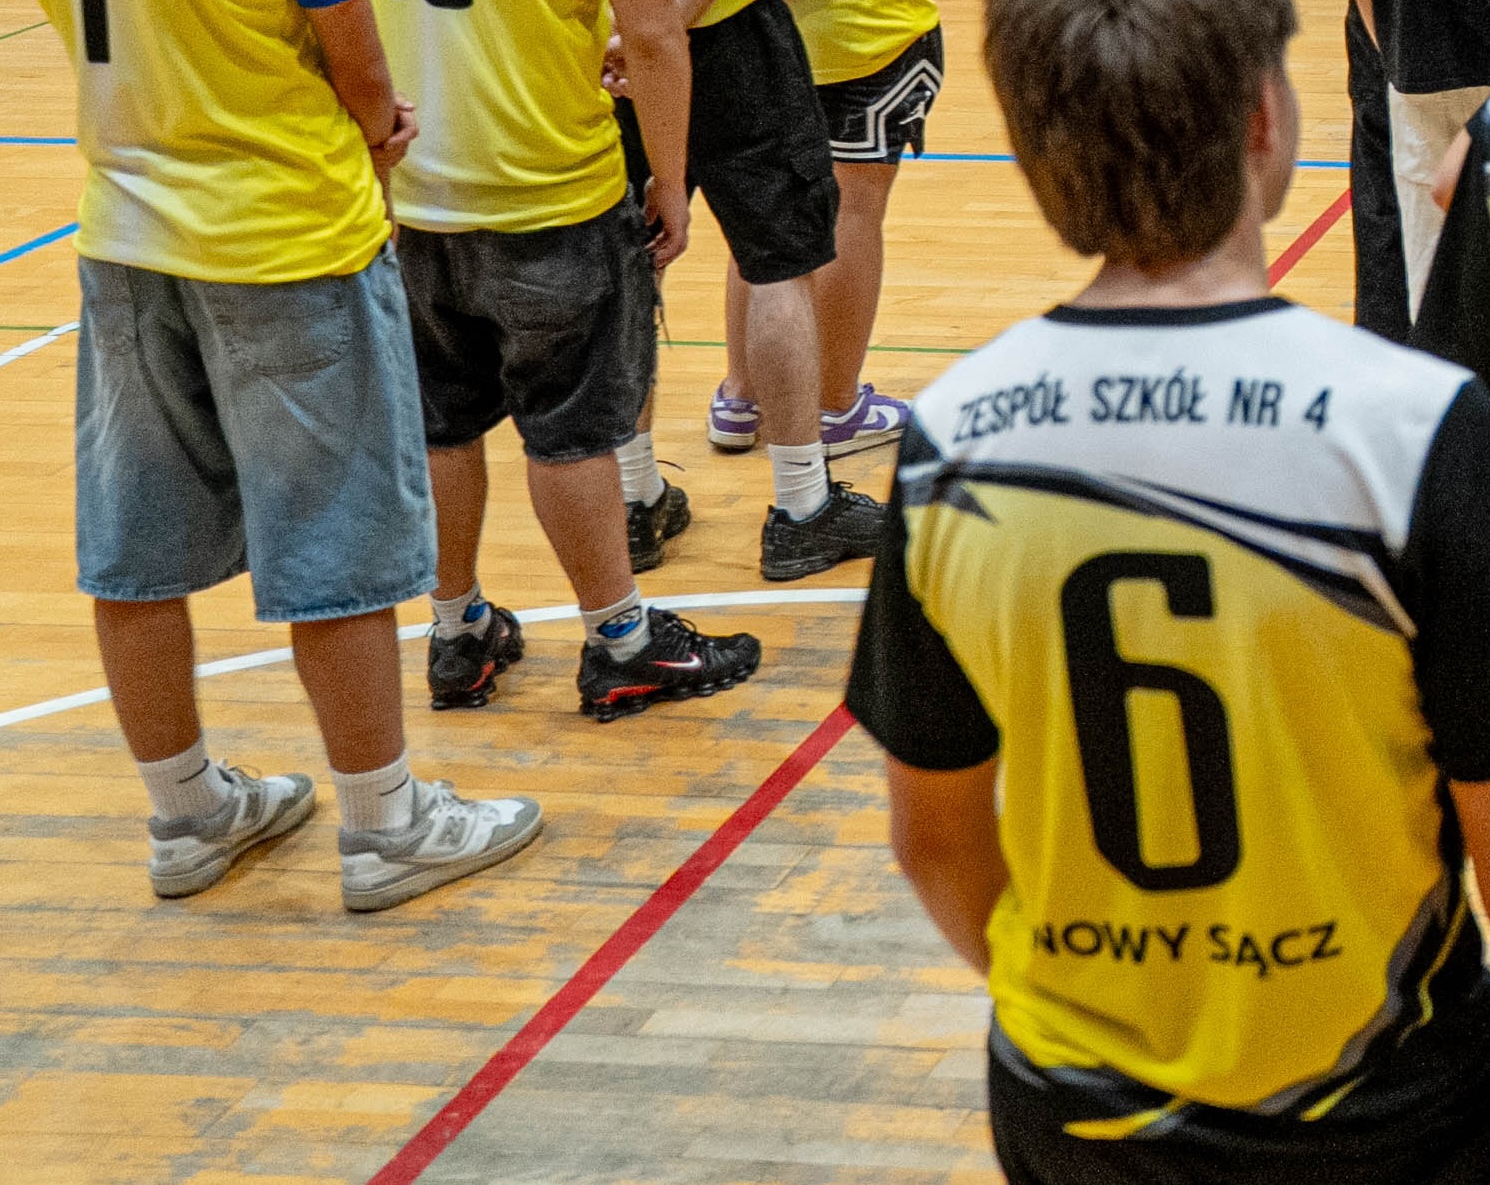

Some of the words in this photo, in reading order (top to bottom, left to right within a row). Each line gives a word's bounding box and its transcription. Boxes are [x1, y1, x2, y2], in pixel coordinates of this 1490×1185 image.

[951, 370, 1071, 444] ZESPÓŁ
[1090, 367, 1207, 426] SZKÓŁ
[1228, 376, 1286, 429] NR
[1304, 387, 1334, 432] 4
[1059, 551, 1244, 895] 6
[1032, 920, 1190, 966] NOWY
[1208, 920, 1344, 980] SĄCZ
